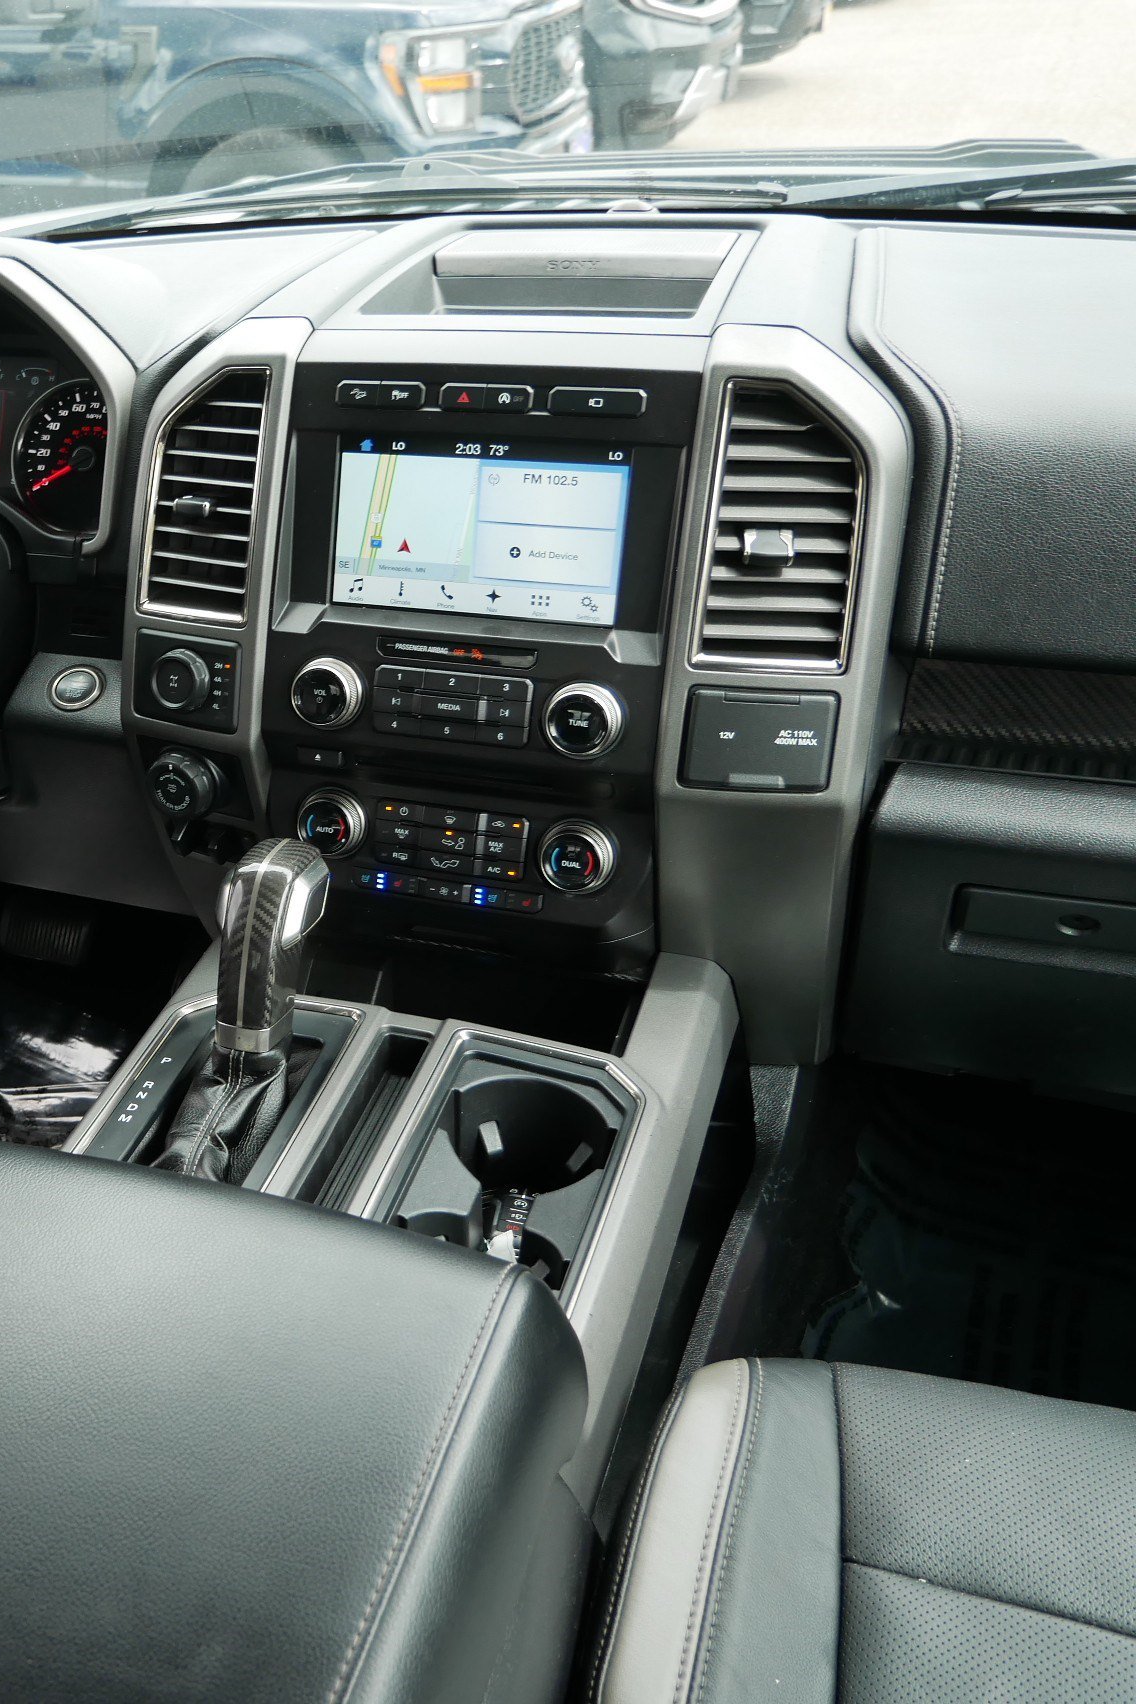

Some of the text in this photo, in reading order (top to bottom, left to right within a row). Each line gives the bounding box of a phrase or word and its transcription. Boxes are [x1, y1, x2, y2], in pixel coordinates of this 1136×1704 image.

[546, 260, 601, 271] SONY
[72, 403, 86, 412] 60
[46, 422, 61, 431] 40
[37, 448, 51, 457] 20
[392, 441, 623, 461] LO 2:03 73° LO
[523, 474, 579, 486] FM 102.5
[529, 550, 579, 561] Add Device
[339, 560, 350, 569] SE
[389, 598, 411, 606] Climate
[437, 602, 455, 610] Phone
[576, 614, 601, 622] Settings
[394, 642, 428, 652] PASSENGER
[428, 645, 449, 654] AIRBAG
[397, 673, 402, 681] 1
[448, 678, 455, 686] 2
[503, 683, 510, 691] 3
[437, 703, 461, 711] MEDIA
[568, 719, 589, 728] TUNE
[444, 727, 450, 735] 5
[719, 731, 735, 739] 12V
[778, 730, 814, 738] AC 110V
[497, 733, 503, 741] 6
[774, 737, 817, 746] 400W MAX
[315, 825, 334, 834] AUTO
[561, 860, 581, 869] DUAL
[487, 866, 501, 874] A/C
[142, 1081, 154, 1089] R
[136, 1091, 148, 1099] N
[126, 1103, 139, 1111] D
[117, 1114, 132, 1123] M
